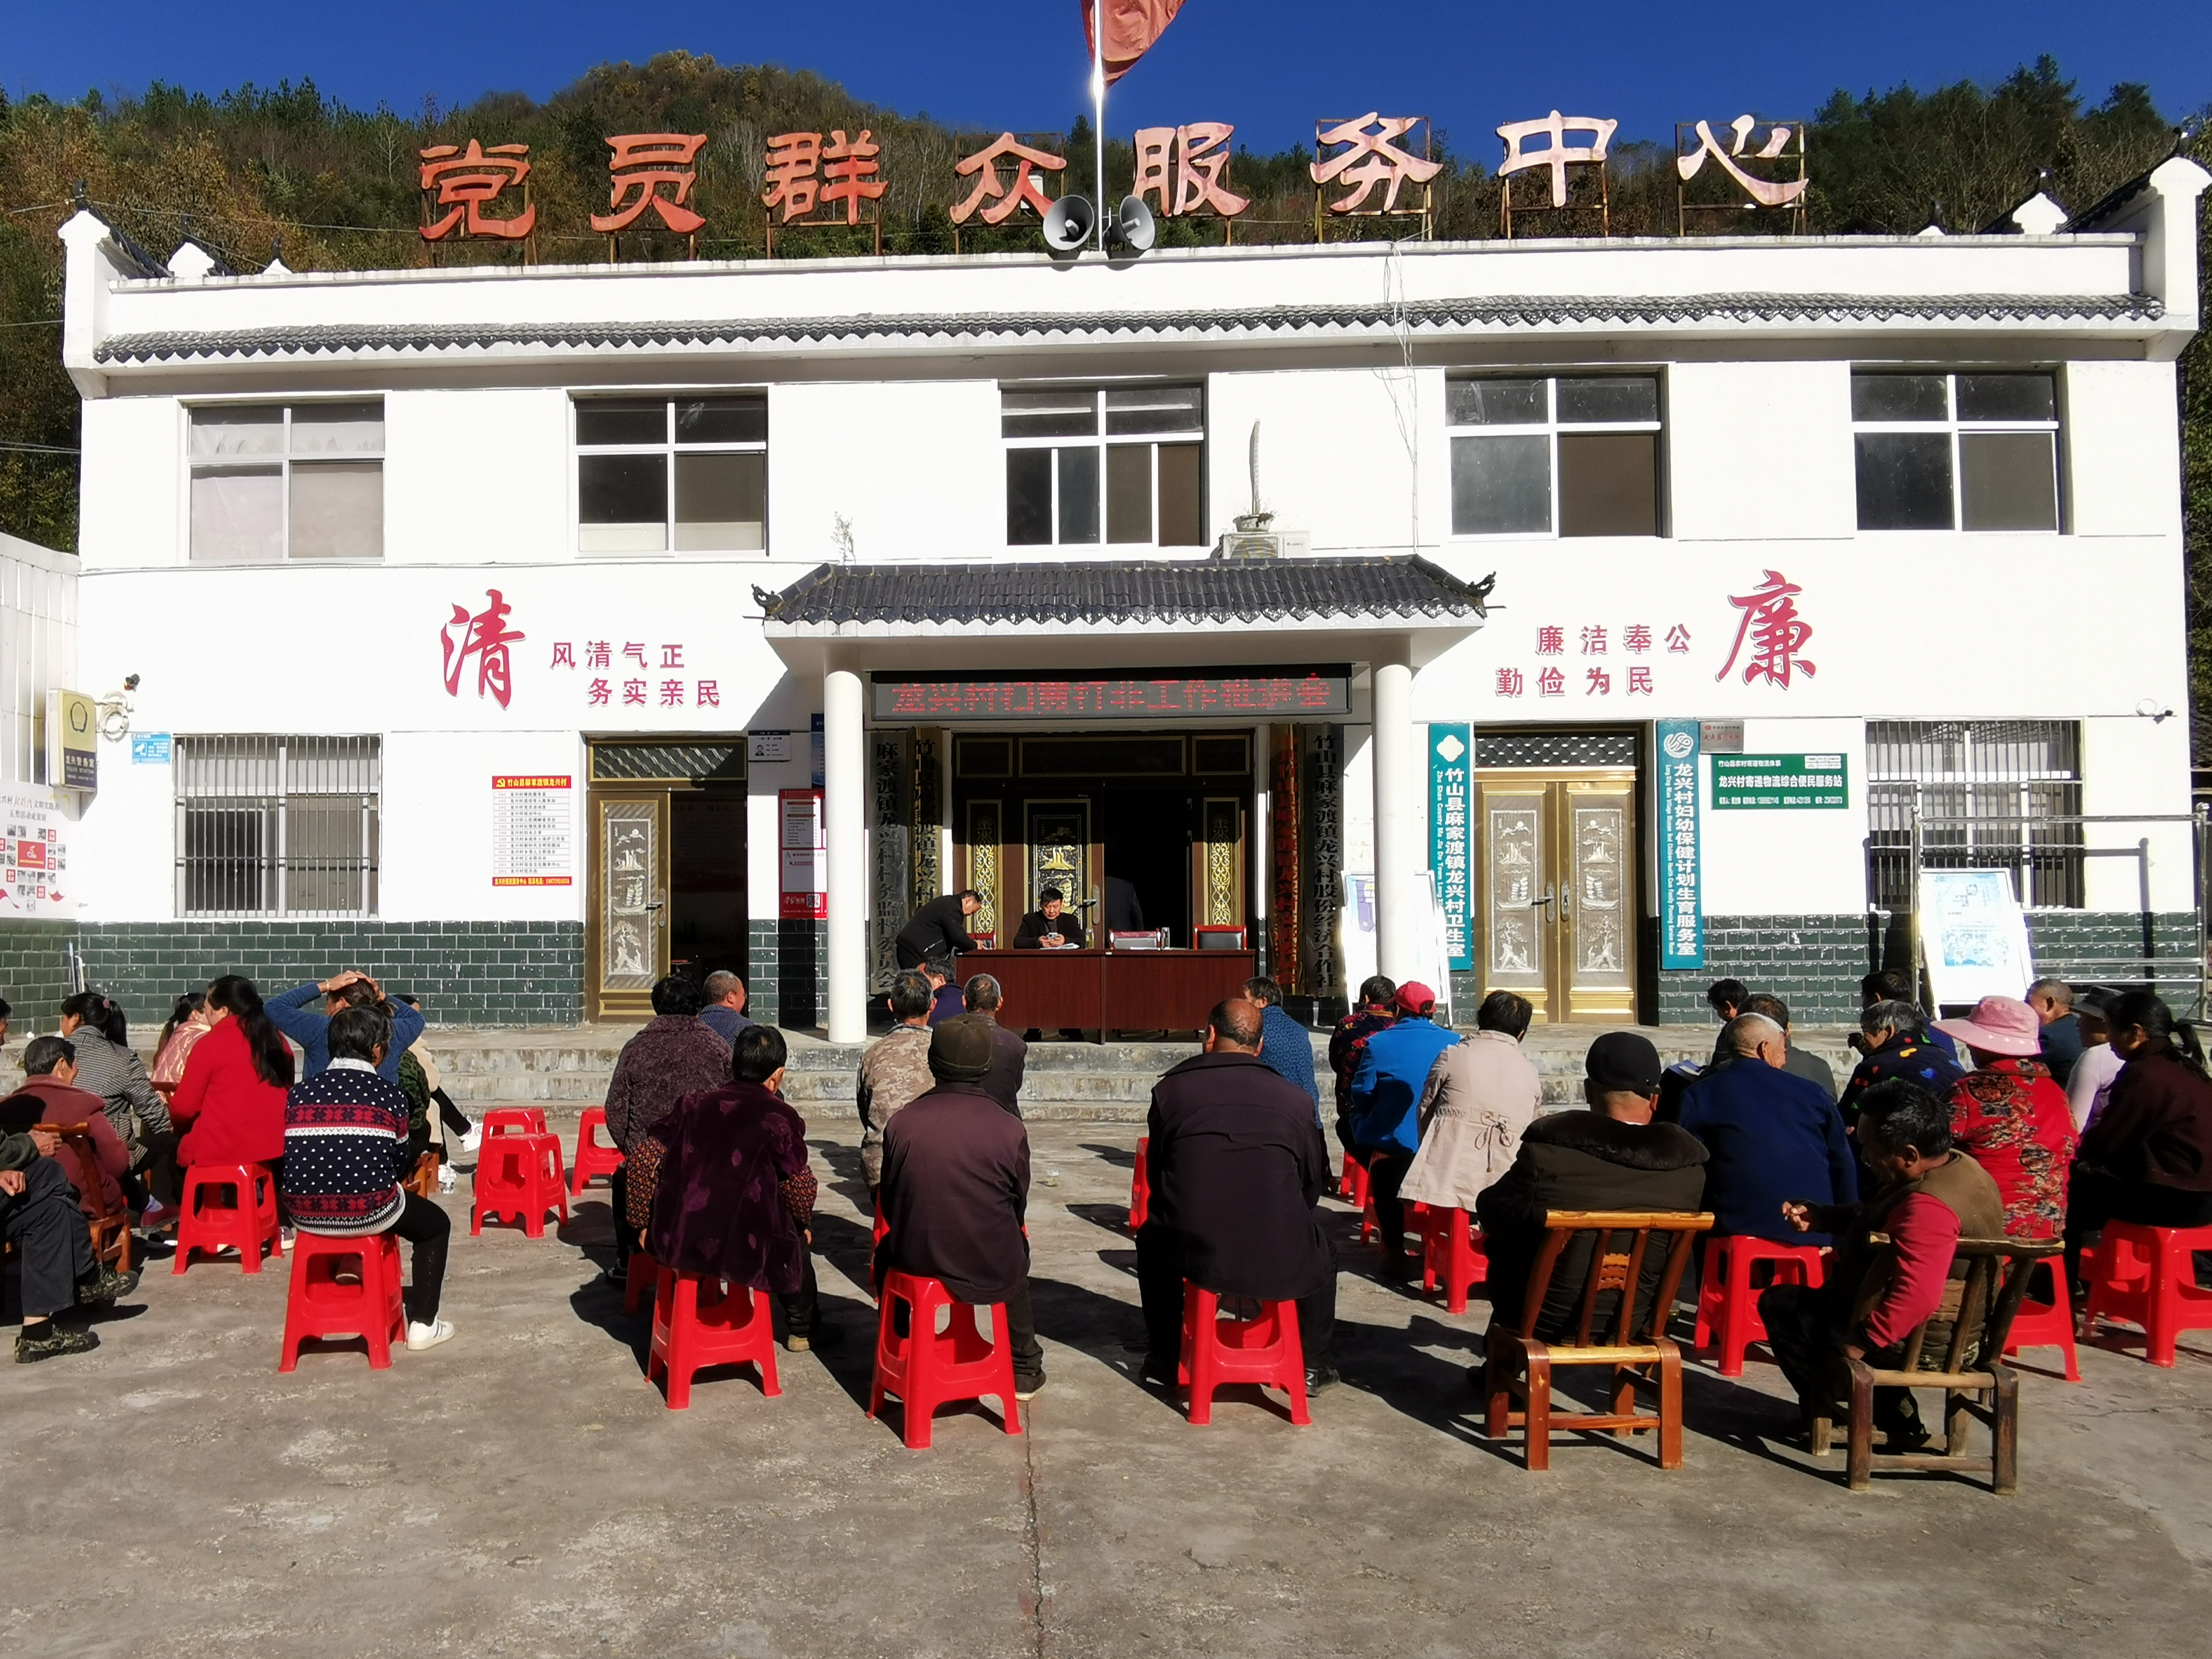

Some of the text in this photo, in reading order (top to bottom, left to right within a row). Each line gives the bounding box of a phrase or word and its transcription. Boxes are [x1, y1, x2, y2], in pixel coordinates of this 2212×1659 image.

[419, 110, 1810, 241] 党员群众服务中心
[441, 589, 525, 708] 清
[551, 641, 684, 668] 风清气正
[1497, 667, 1653, 695] 勤俭为民
[1538, 624, 1690, 653] 廉洁奉公
[1716, 570, 1816, 689] 廉
[589, 678, 720, 706] 务实亲民
[1718, 774, 1843, 788] 龙兴村寄递物流综合便民服务站
[1313, 735, 1338, 989] 竹山县麻家渡镇龙兴村股份经济合作社
[1444, 767, 1466, 957] 竹山县麻家渡镇龙兴村卫生室
[1674, 764, 1697, 956] 龙兴村妇幼保健计划生育服务室
